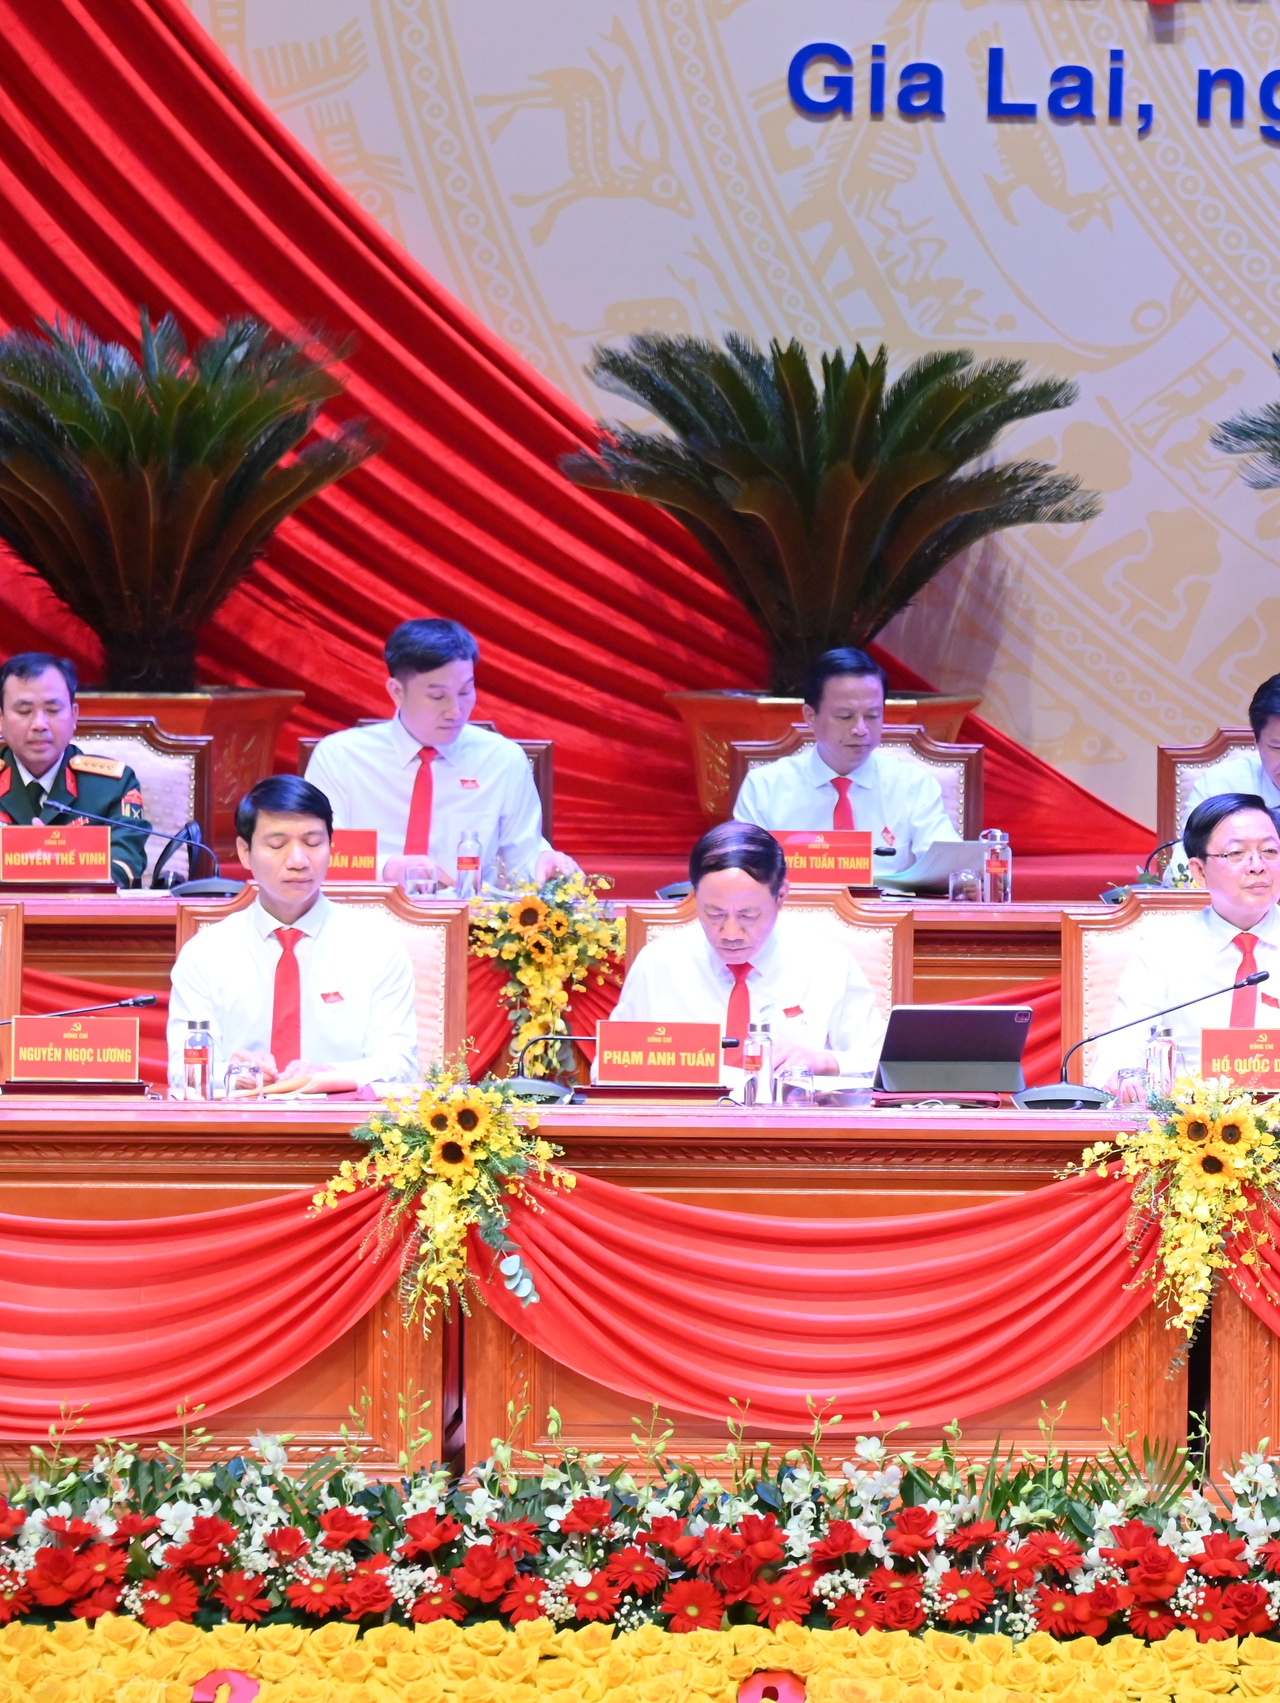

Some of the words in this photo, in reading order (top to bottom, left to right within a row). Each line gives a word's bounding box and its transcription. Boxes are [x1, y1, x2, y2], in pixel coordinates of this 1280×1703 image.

[788, 42, 946, 115] Gia
[987, 47, 1155, 132] Lai,
[5, 849, 51, 865] NGUYỄN
[55, 849, 75, 865] THẾ
[79, 852, 106, 865] VINH
[351, 855, 375, 869] ANH
[809, 853, 836, 869] TUẤN
[837, 856, 870, 870] THANH
[19, 1042, 62, 1062] NGUYỄN
[65, 1047, 94, 1065] NGỌC
[97, 1047, 131, 1063] LƯƠNG
[603, 1050, 643, 1068] PHẠM
[647, 1051, 675, 1066] ANH
[680, 1048, 715, 1067] TUẤN
[1234, 1054, 1270, 1074] QUỐC
